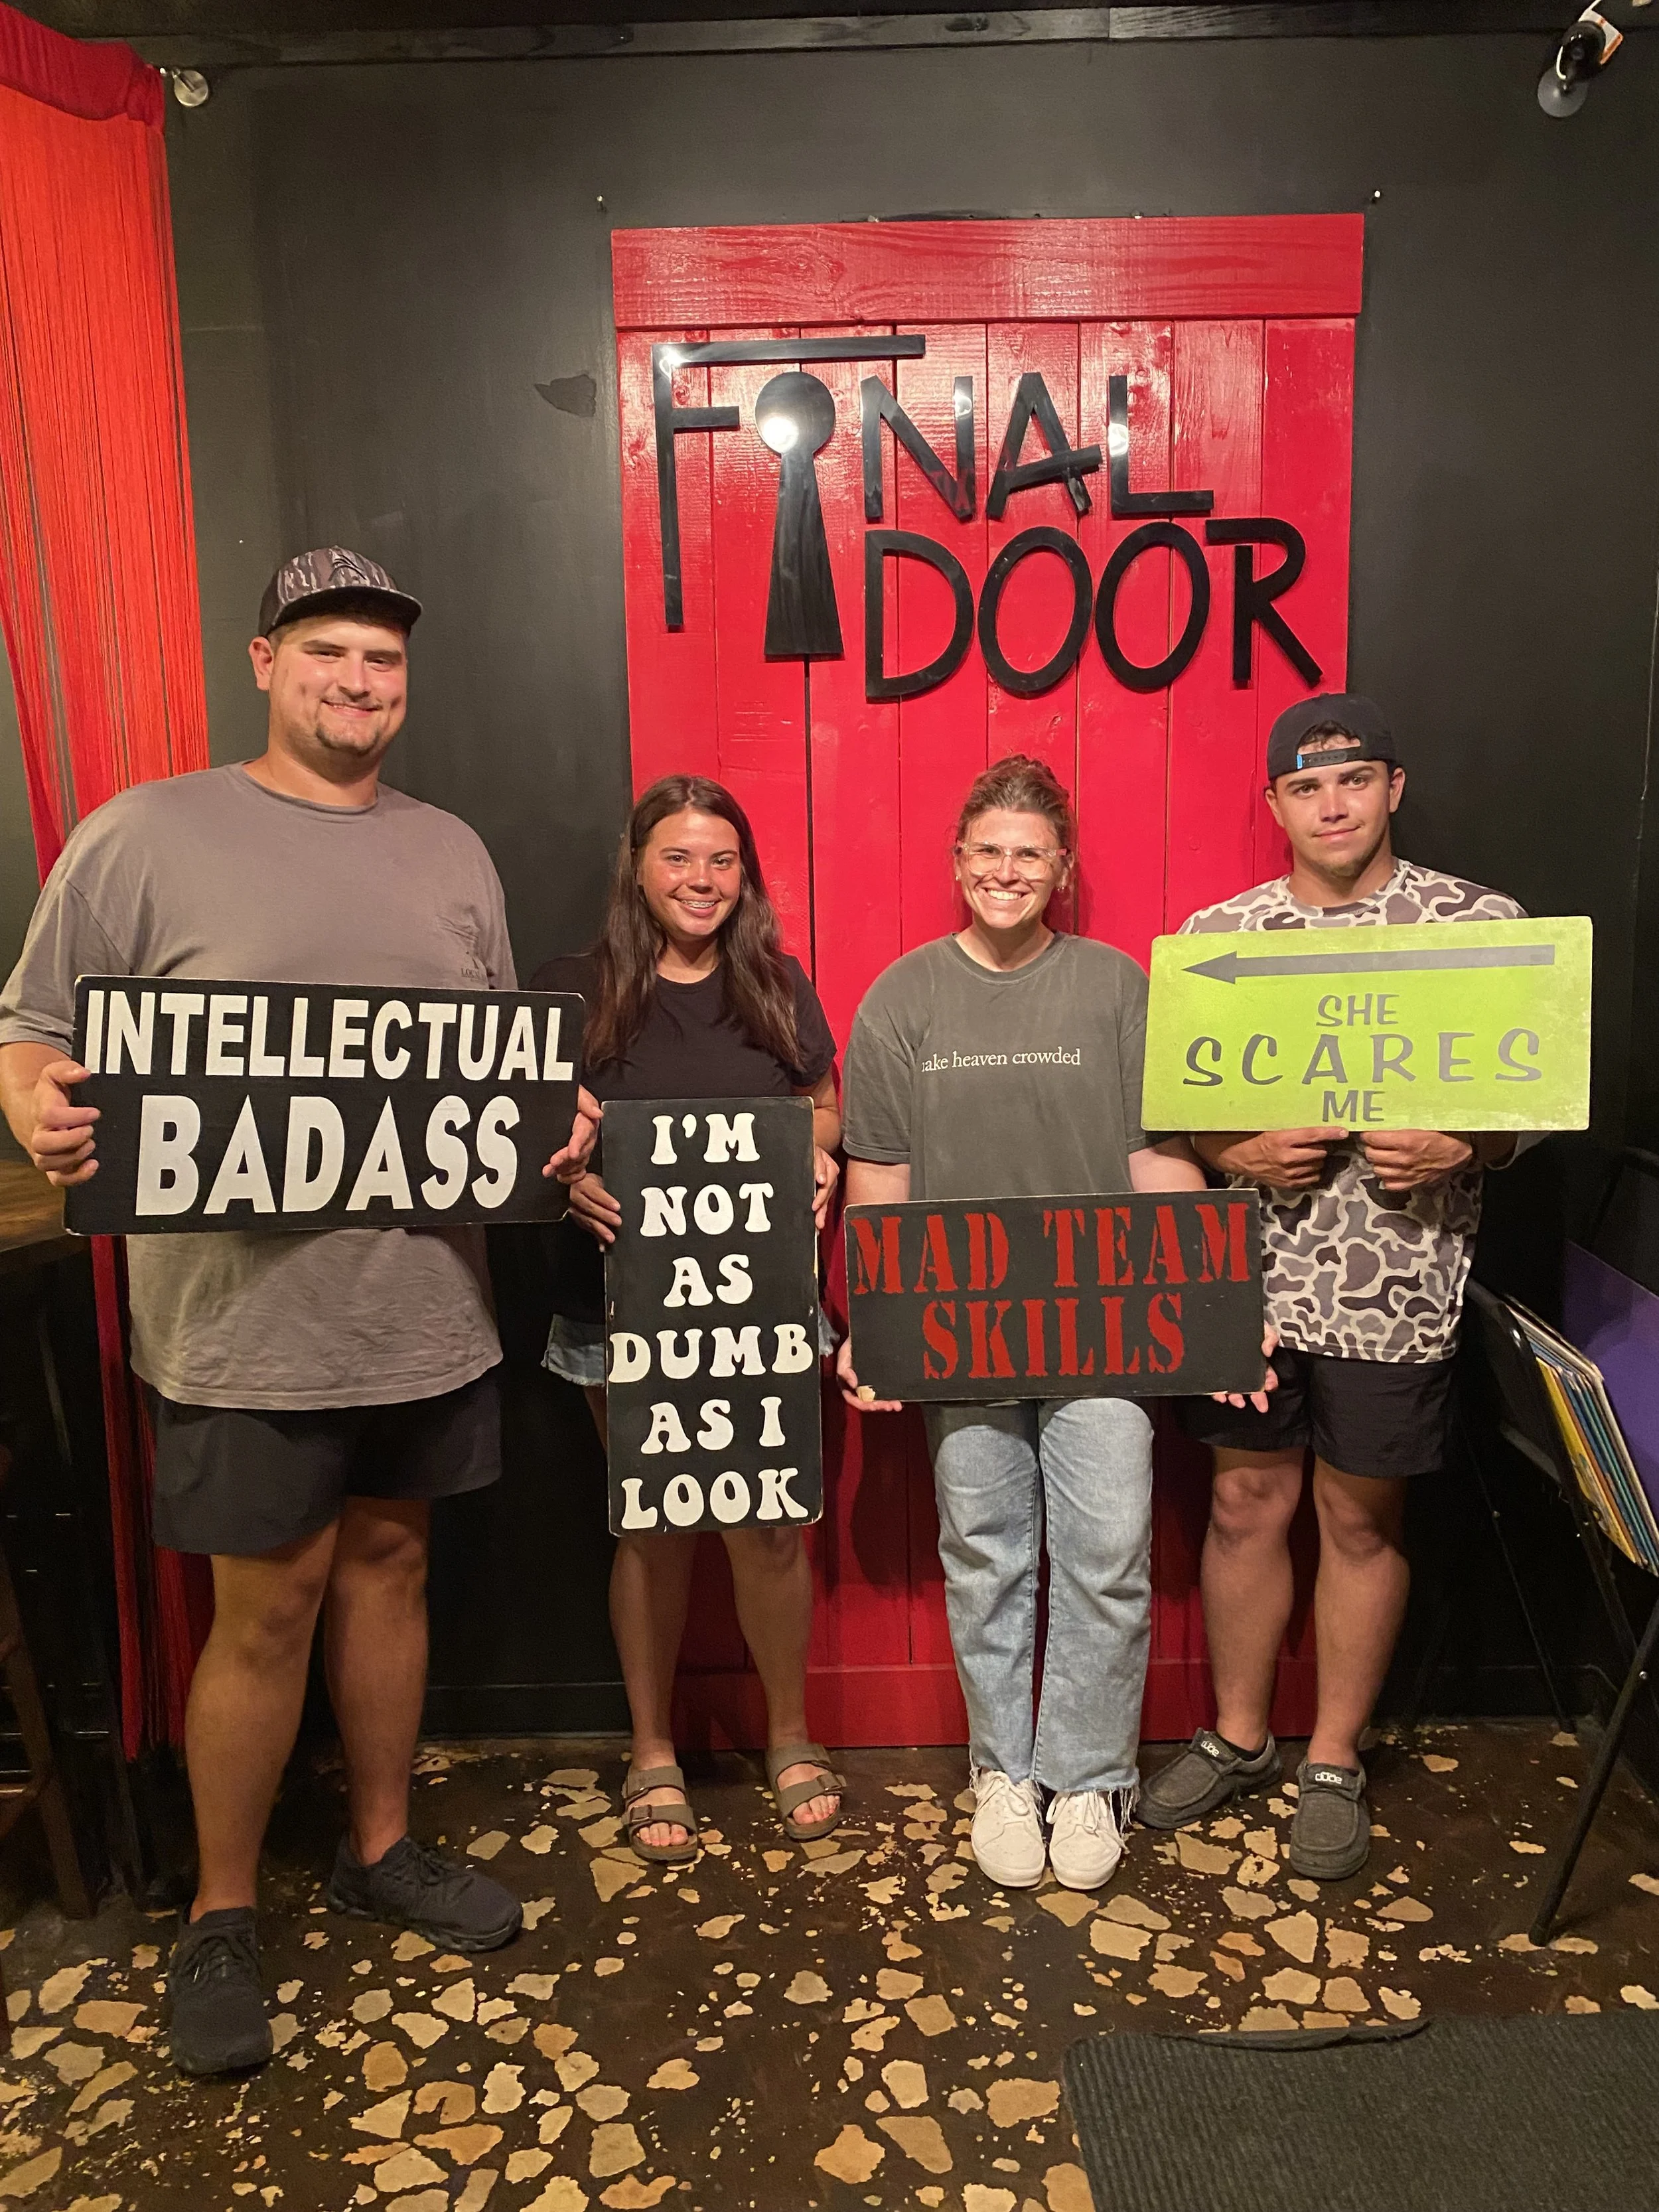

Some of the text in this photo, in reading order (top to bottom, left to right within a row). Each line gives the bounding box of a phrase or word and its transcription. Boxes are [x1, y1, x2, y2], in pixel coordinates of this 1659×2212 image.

[865, 517, 1323, 700] DOOR
[85, 990, 574, 1081] INTELLECTUAL
[1316, 993, 1400, 1027] SHE
[922, 1046, 1081, 1072] ake heaven crowded
[1183, 1028, 1543, 1087] SCARES
[1322, 1090, 1386, 1123] ME
[135, 1094, 520, 1217] BADASS
[650, 1112, 760, 1165] I'M
[640, 1182, 773, 1238] NOT
[851, 1203, 1252, 1295] MAD TEAM
[663, 1254, 753, 1307] AS
[609, 1323, 814, 1383] DUMB
[922, 1293, 1186, 1380] SKILLS
[641, 1396, 786, 1455] AS I
[621, 1467, 809, 1530] LOOK
